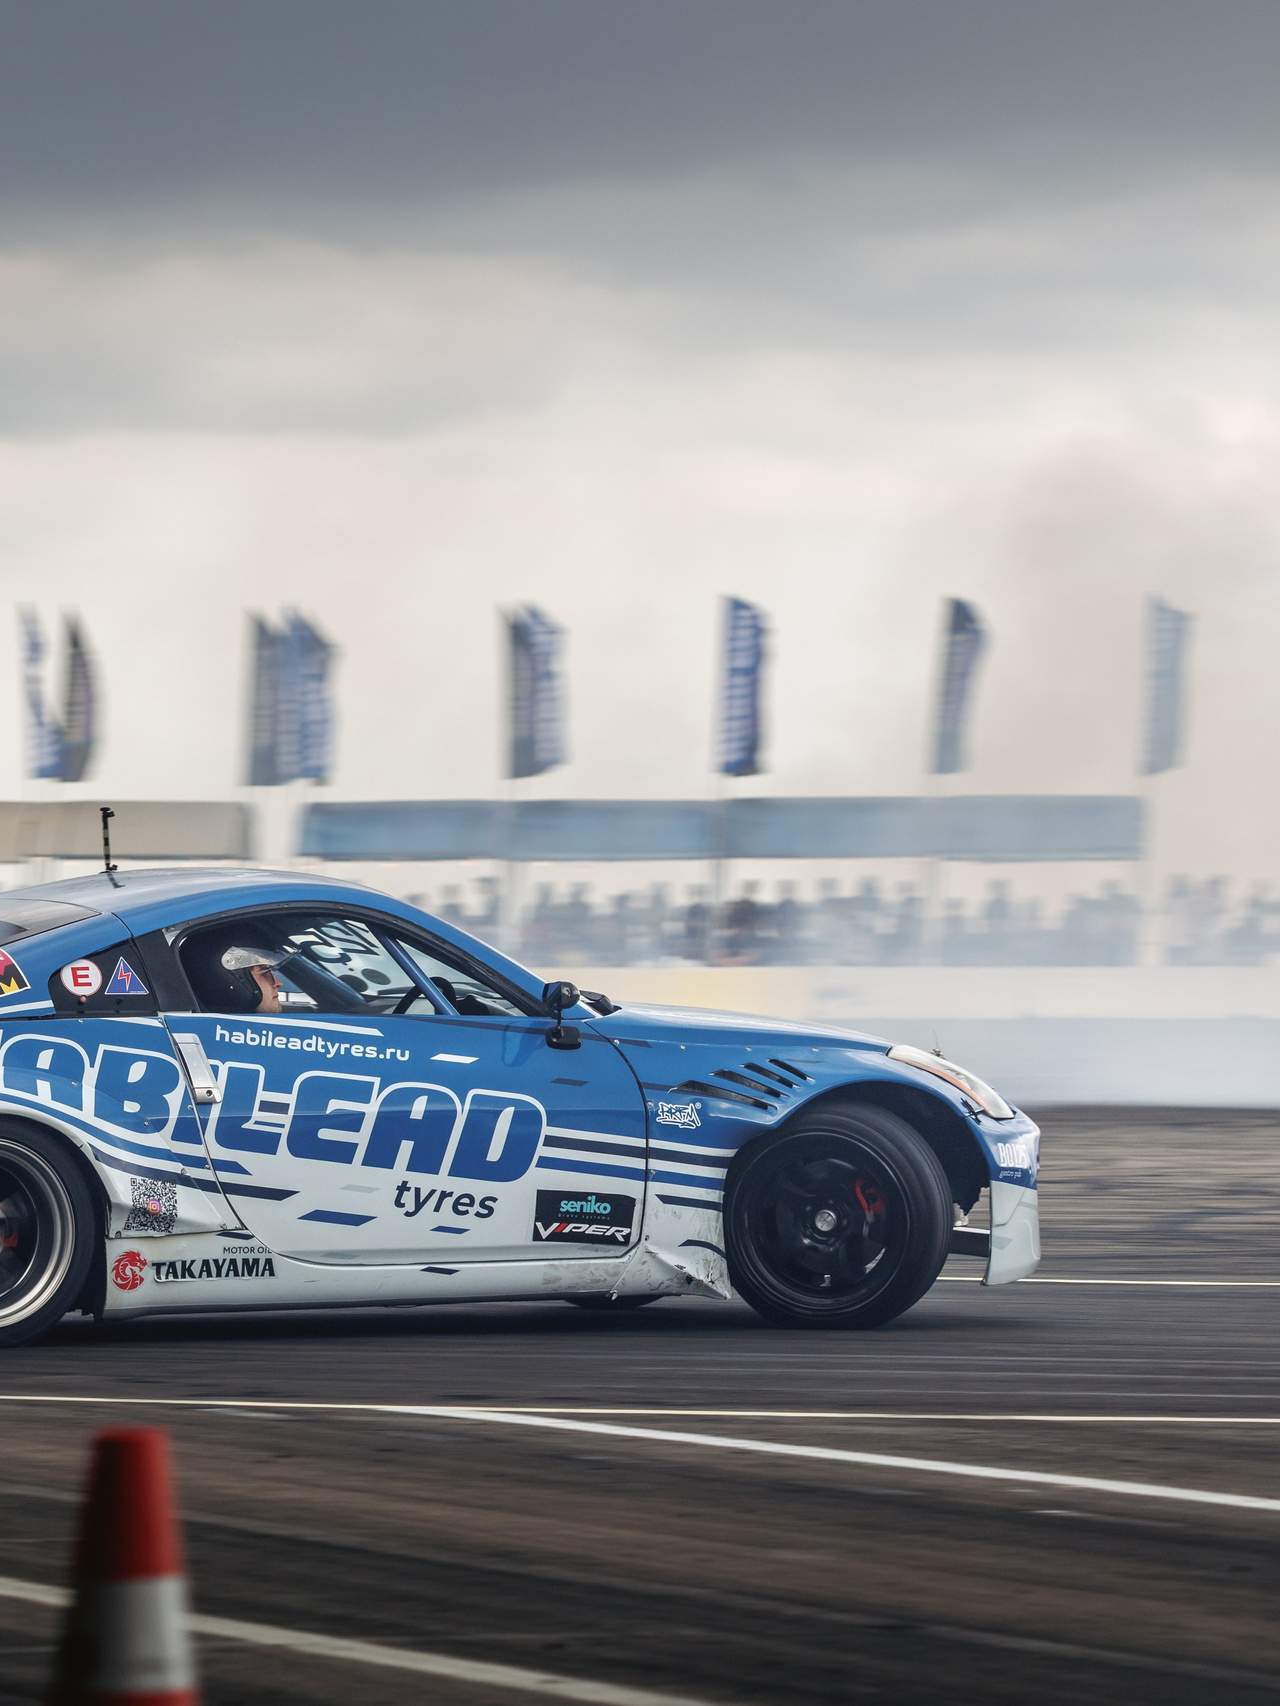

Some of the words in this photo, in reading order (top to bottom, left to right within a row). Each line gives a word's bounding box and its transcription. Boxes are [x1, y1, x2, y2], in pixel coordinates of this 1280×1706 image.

[70, 966, 92, 987] E
[215, 1024, 410, 1062] habileadtyres.ru
[394, 1180, 499, 1218] tyres
[559, 1195, 611, 1214] seniko
[535, 1222, 631, 1242] VIPER
[222, 1246, 256, 1255] MOTOR
[257, 1246, 273, 1255] OIL
[152, 1257, 276, 1281] TAKAYAMA
